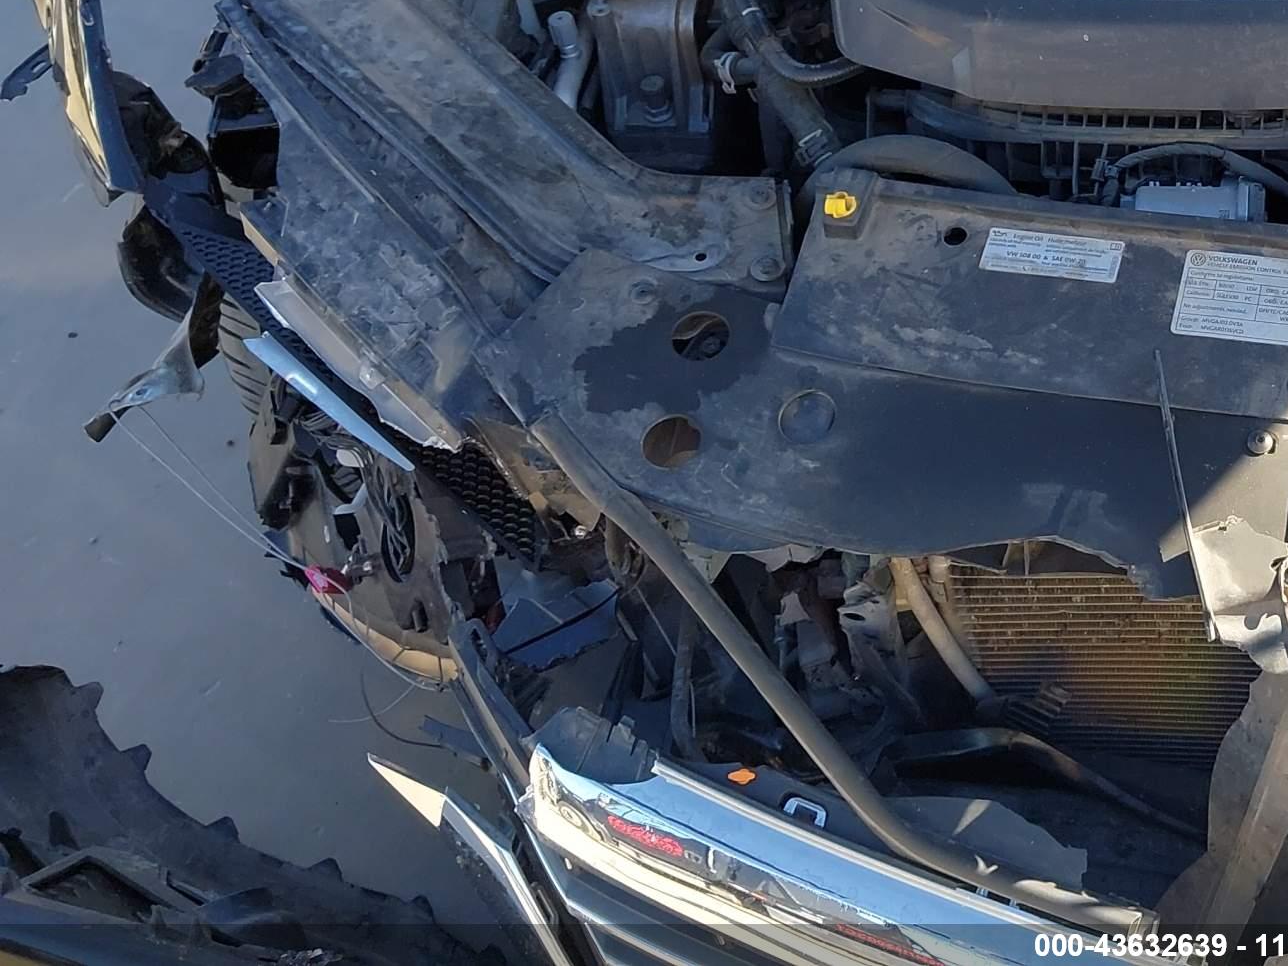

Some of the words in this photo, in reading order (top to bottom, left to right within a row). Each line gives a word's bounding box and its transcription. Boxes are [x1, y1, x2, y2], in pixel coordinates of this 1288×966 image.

[1006, 250, 1019, 258] VW
[1051, 255, 1064, 263] SAE
[1207, 255, 1258, 267] VOLKSWAGEN
